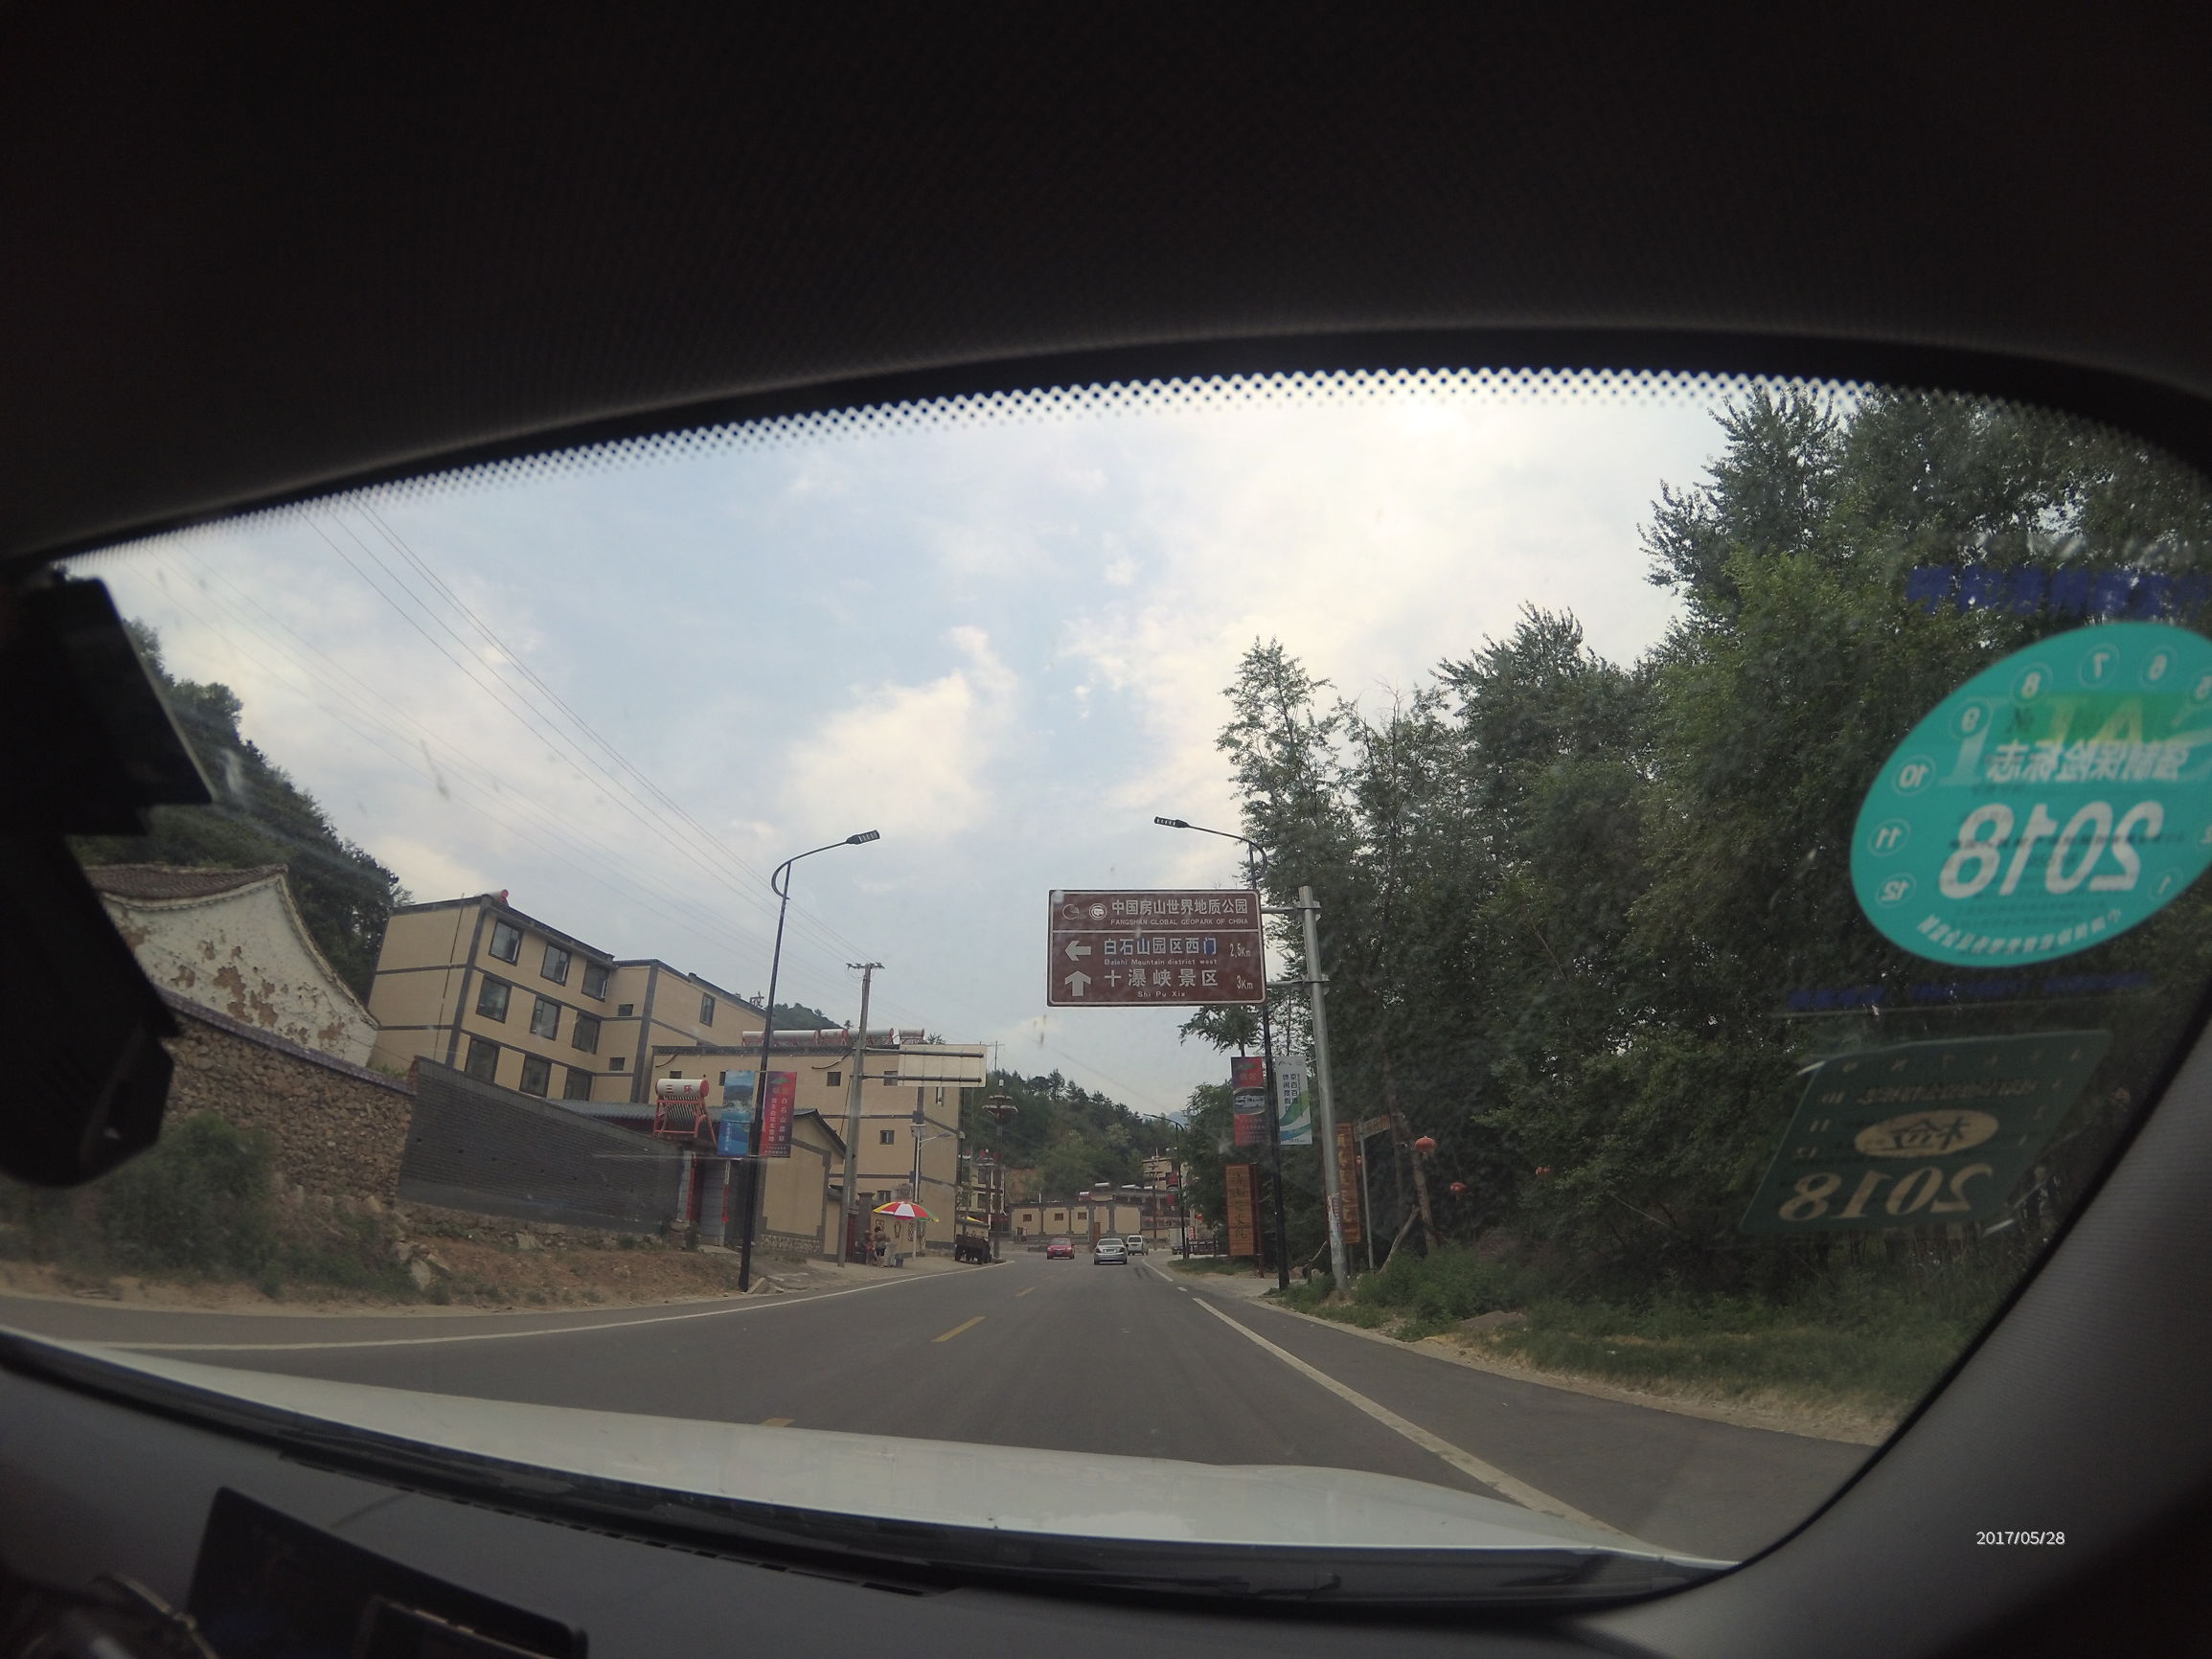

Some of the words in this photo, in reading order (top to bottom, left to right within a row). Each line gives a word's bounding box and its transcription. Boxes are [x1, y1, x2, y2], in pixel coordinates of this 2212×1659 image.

[1111, 898, 1248, 916] 中国房山世界地质公园
[1104, 937, 1217, 955] 白石山园区西门
[1104, 968, 1219, 988] 十瀑峡景区
[1236, 974, 1253, 989] 3Km
[666, 1084, 693, 1094] 三环
